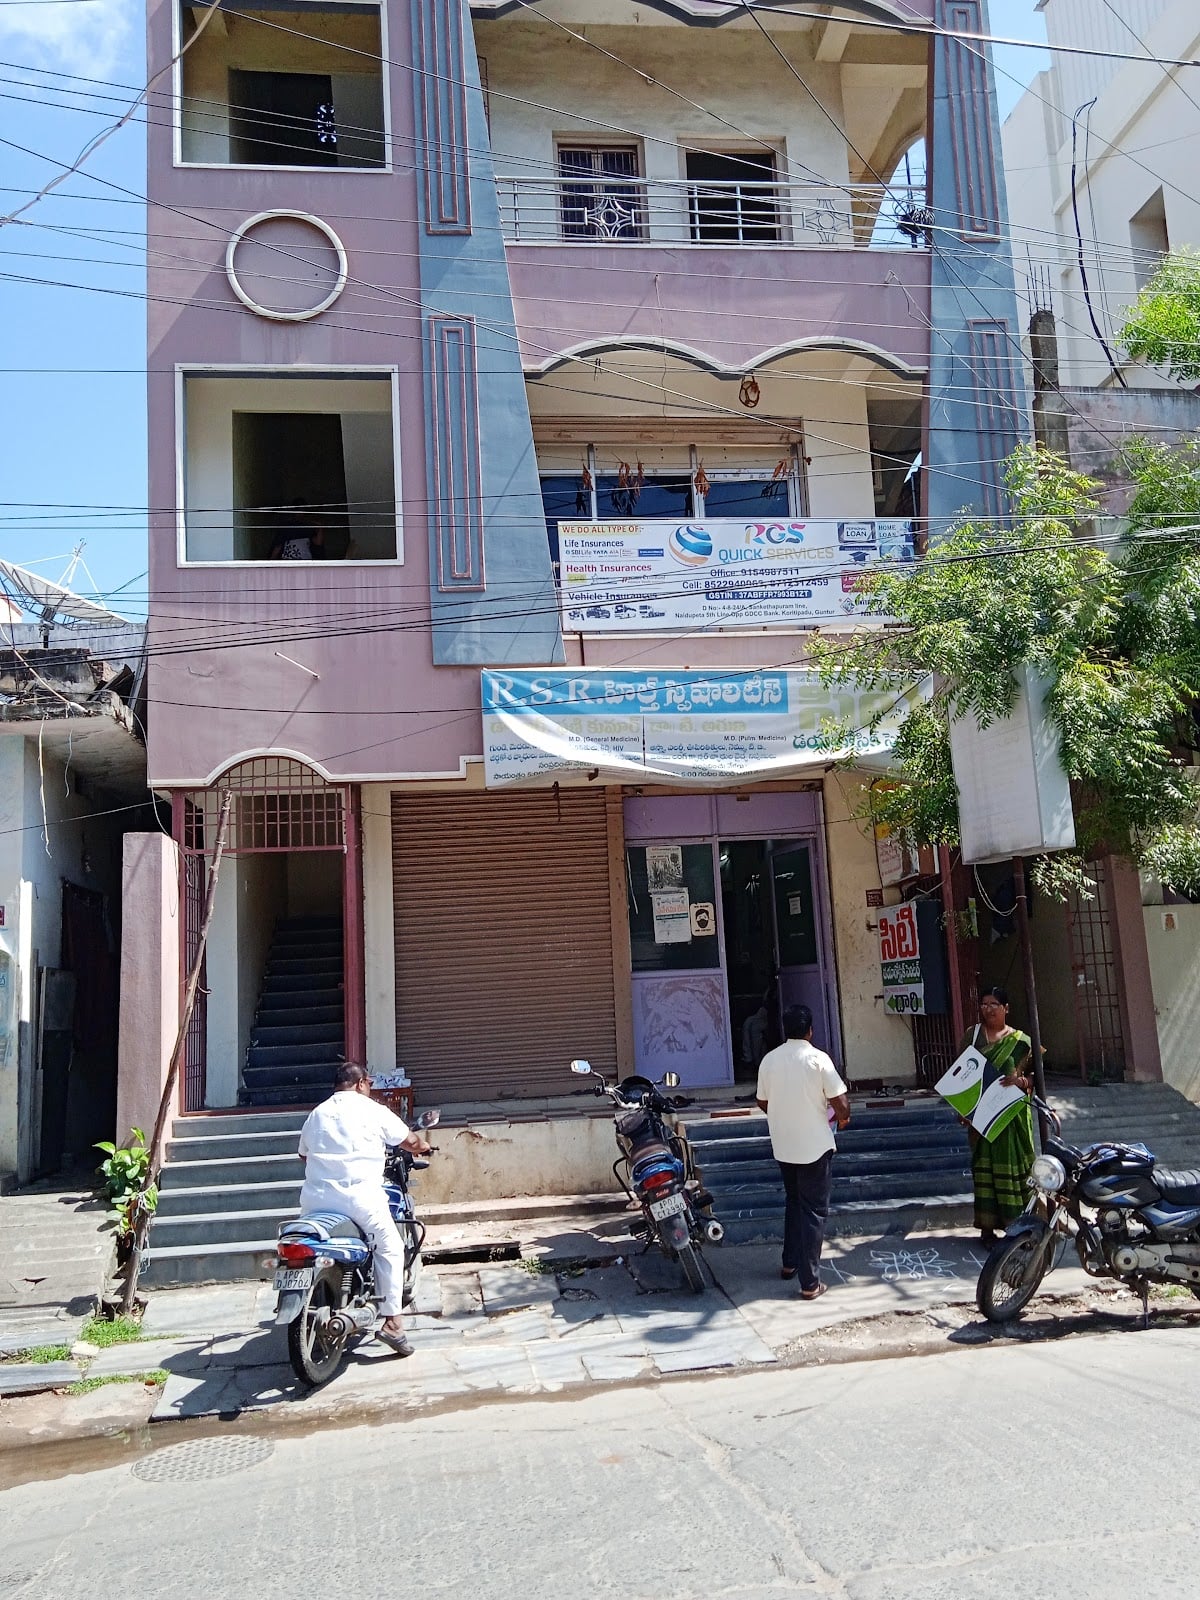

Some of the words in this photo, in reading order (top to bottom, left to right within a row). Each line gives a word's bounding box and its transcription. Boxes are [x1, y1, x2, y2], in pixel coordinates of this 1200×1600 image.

[562, 525, 575, 534] WE
[577, 525, 589, 534] DO
[591, 525, 605, 533] ALL
[608, 525, 626, 533] TYPE
[745, 523, 806, 544] RGS
[564, 539, 579, 547] Life
[581, 539, 624, 547] Insurances
[718, 548, 762, 563] QUICK
[767, 548, 834, 560] SERVICES
[566, 564, 597, 572] Health
[600, 564, 652, 572] Insurances
[682, 580, 702, 589] Cell:
[568, 592, 603, 601] Vehicle
[283, 1270, 305, 1280] AP07
